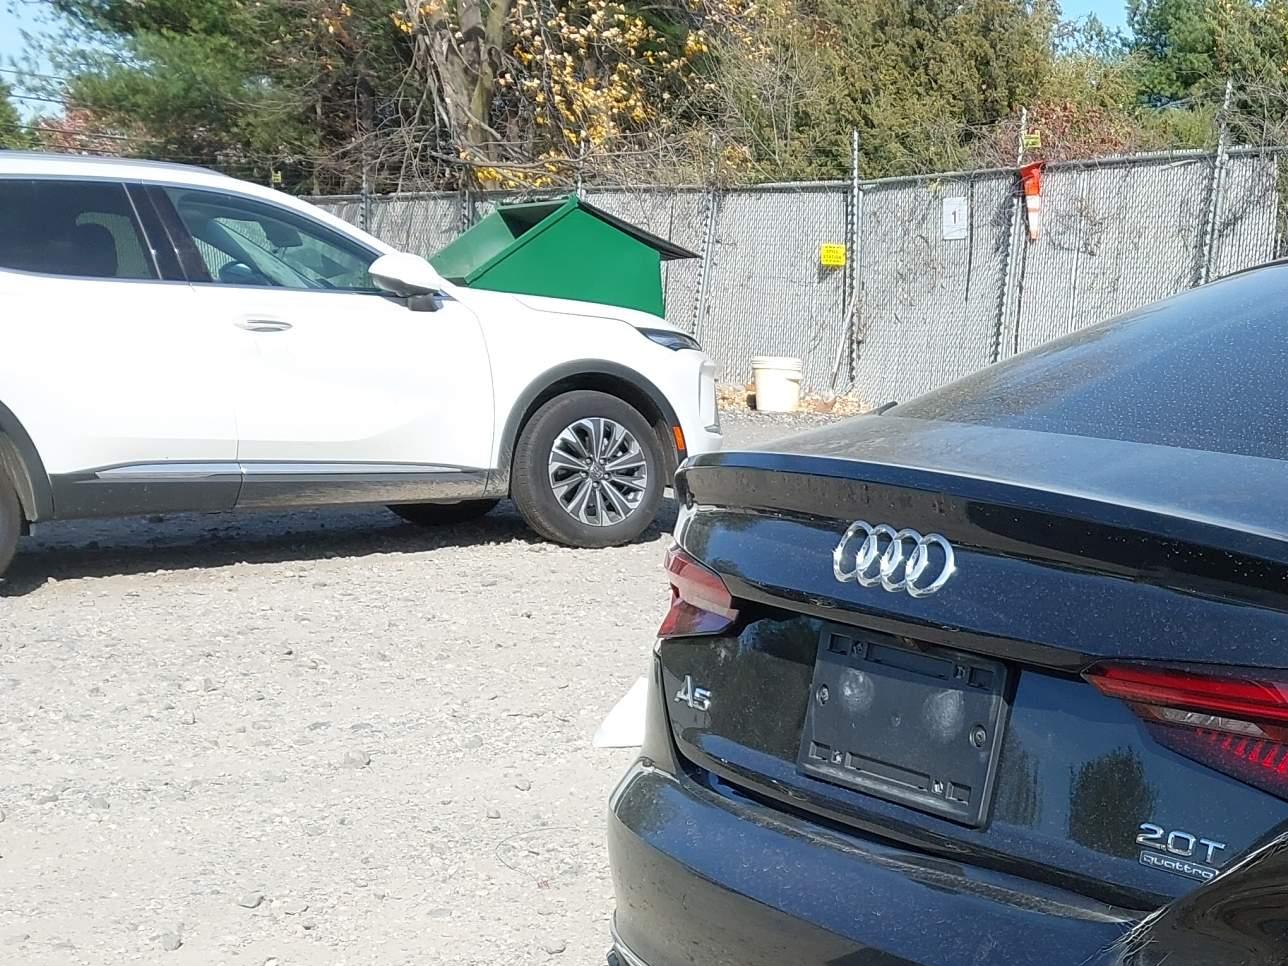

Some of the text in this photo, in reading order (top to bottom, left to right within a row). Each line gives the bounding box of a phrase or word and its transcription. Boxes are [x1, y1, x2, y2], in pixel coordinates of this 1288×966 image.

[673, 675, 712, 711] A5
[1136, 822, 1226, 863] 2.0T
[1142, 854, 1215, 880] quattro
